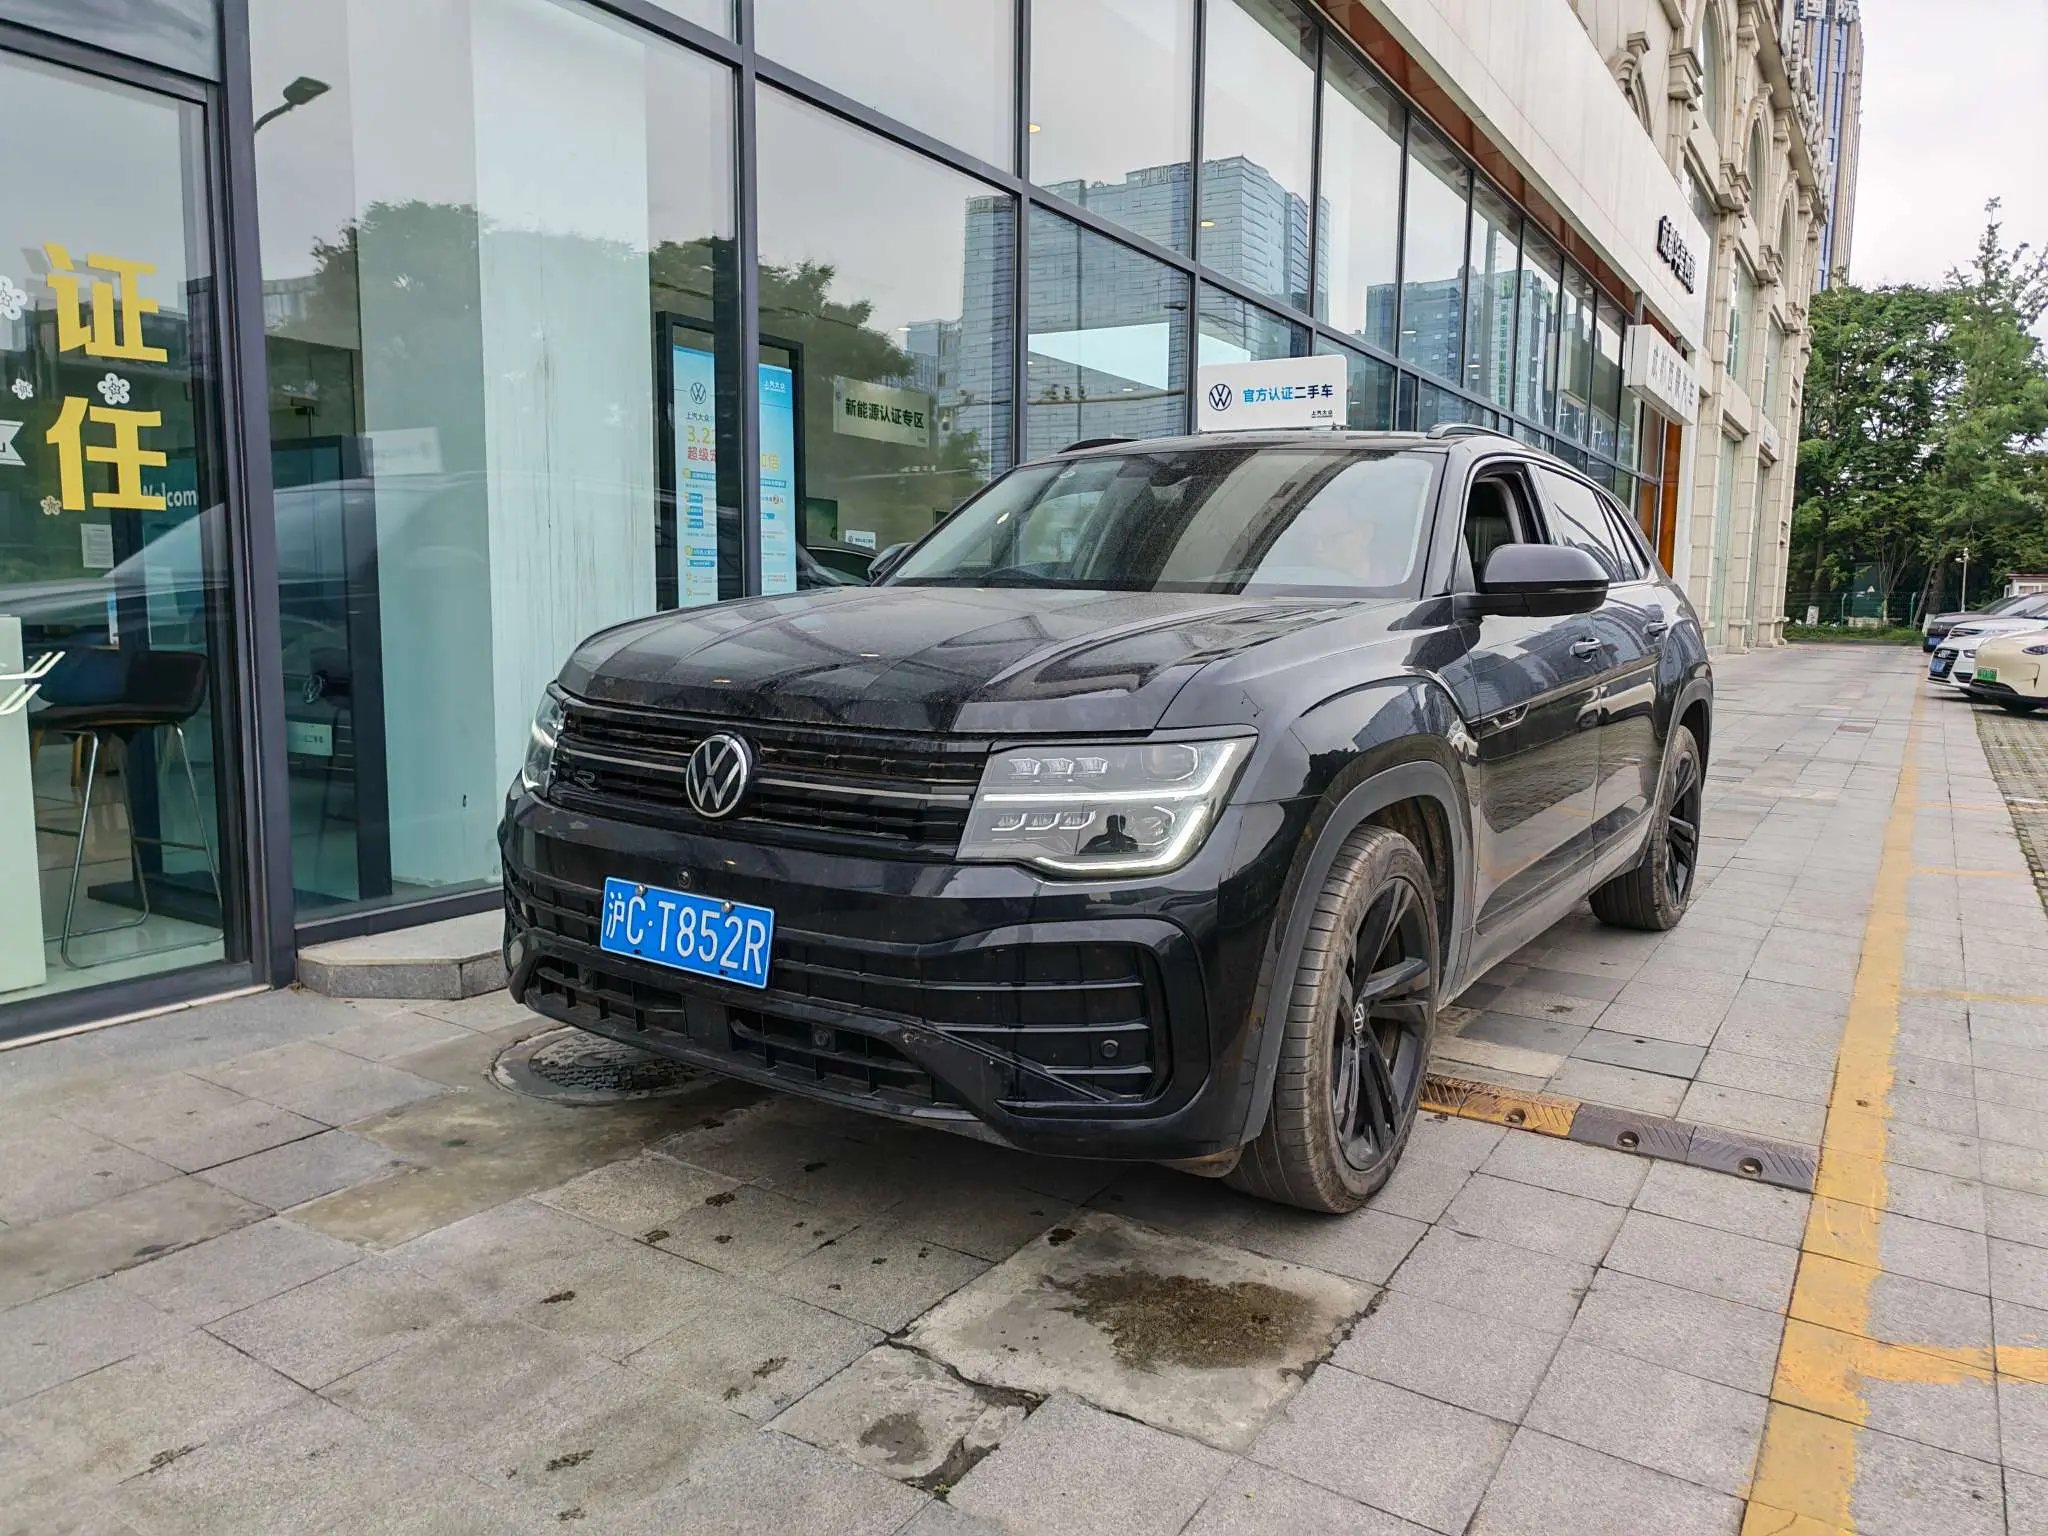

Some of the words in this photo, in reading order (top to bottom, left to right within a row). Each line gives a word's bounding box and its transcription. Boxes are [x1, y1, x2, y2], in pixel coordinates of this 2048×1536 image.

[43, 242, 168, 364] 证
[1243, 384, 1333, 404] 官方认证二手车
[845, 398, 925, 429] 新能源认证专区
[687, 425, 716, 445] 3.2
[46, 396, 168, 512] 任
